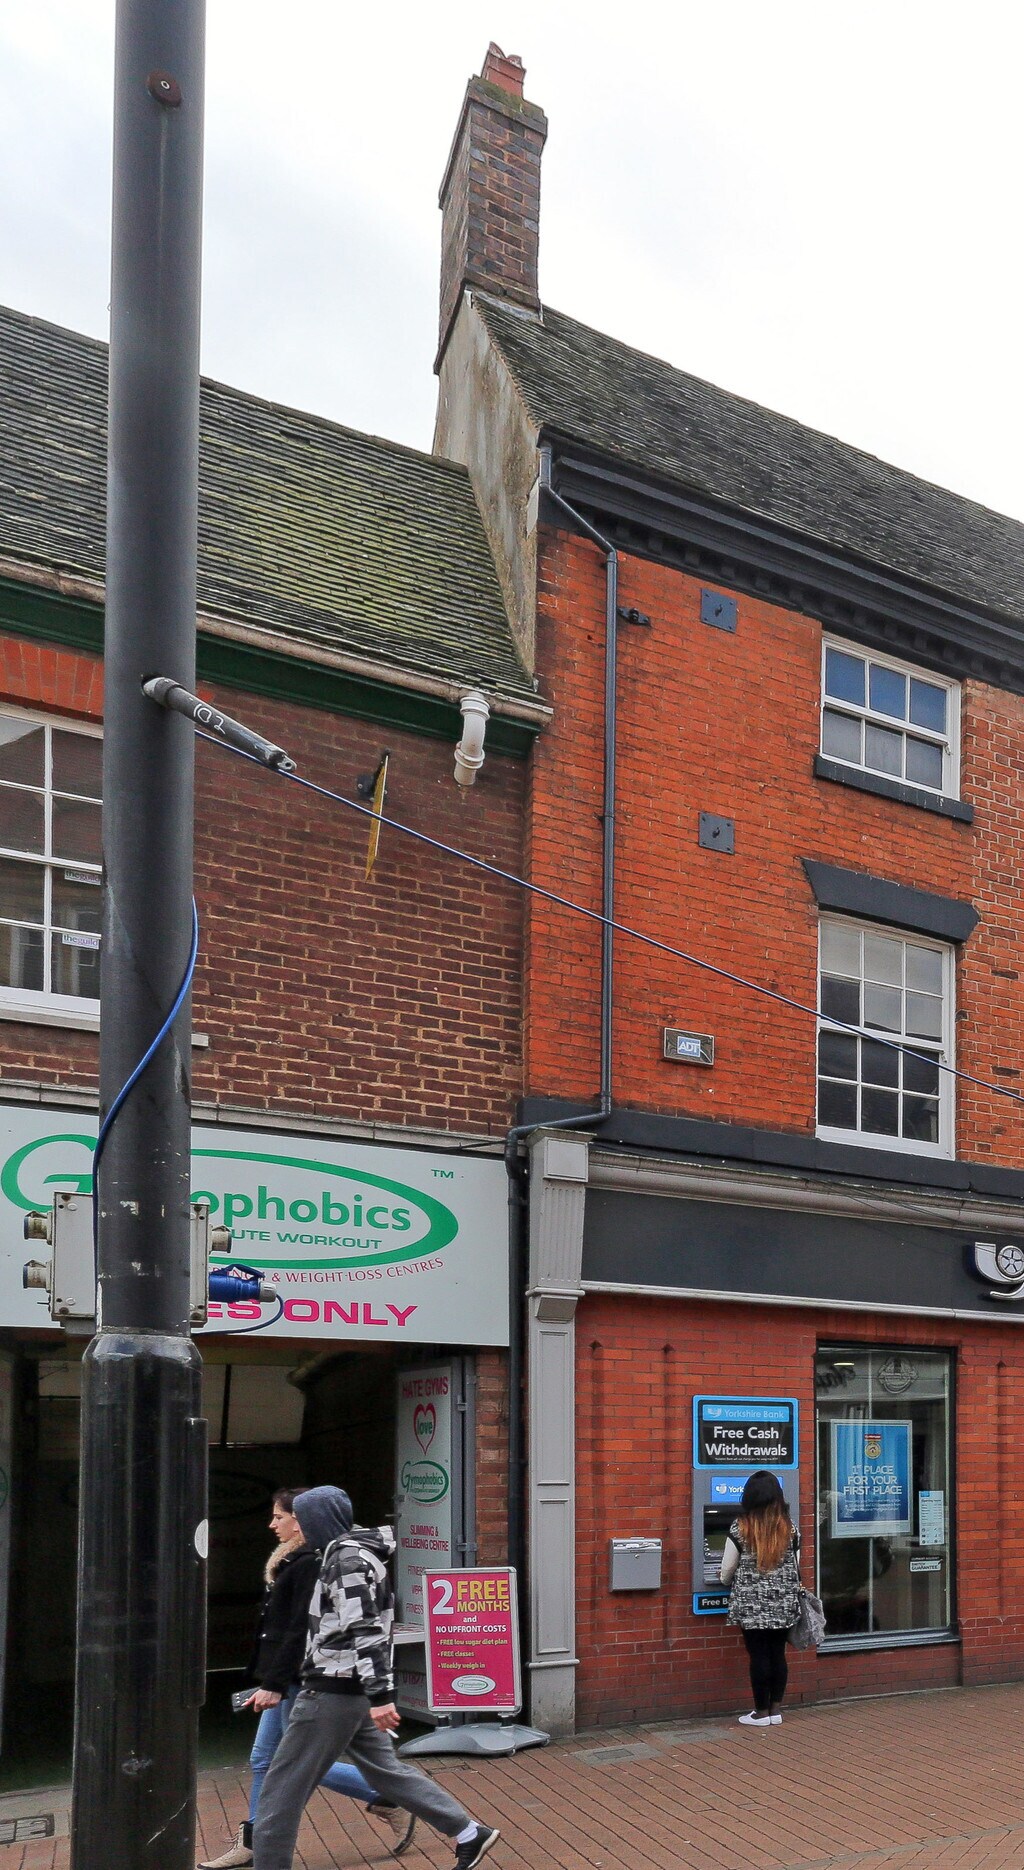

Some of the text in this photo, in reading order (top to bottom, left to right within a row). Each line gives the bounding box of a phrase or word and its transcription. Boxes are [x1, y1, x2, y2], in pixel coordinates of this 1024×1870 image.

[680, 1041, 700, 1053] ADT
[431, 1169, 454, 1179] TM
[277, 1232, 382, 1249] WORKOUT
[272, 1273, 281, 1282] &
[386, 1257, 444, 1278] CENTRES
[283, 1298, 418, 1327] ONLY
[402, 1376, 449, 1399] HATE GYMS
[724, 1409, 784, 1419] Yorkshire Bank
[417, 1421, 433, 1434] love
[713, 1426, 779, 1439] Free Cash
[705, 1443, 787, 1456] Withdrawals
[864, 1465, 894, 1474] PLACE
[848, 1475, 897, 1485] FOR YOUR
[843, 1486, 902, 1495] FIRST PLACE
[410, 1525, 439, 1537] SLIMMING &
[401, 1538, 449, 1551] WELLBEING CENTRE
[457, 1580, 510, 1600] FREE
[432, 1580, 454, 1615] 2
[457, 1601, 510, 1613] MONTHS
[495, 1638, 508, 1646] plan
